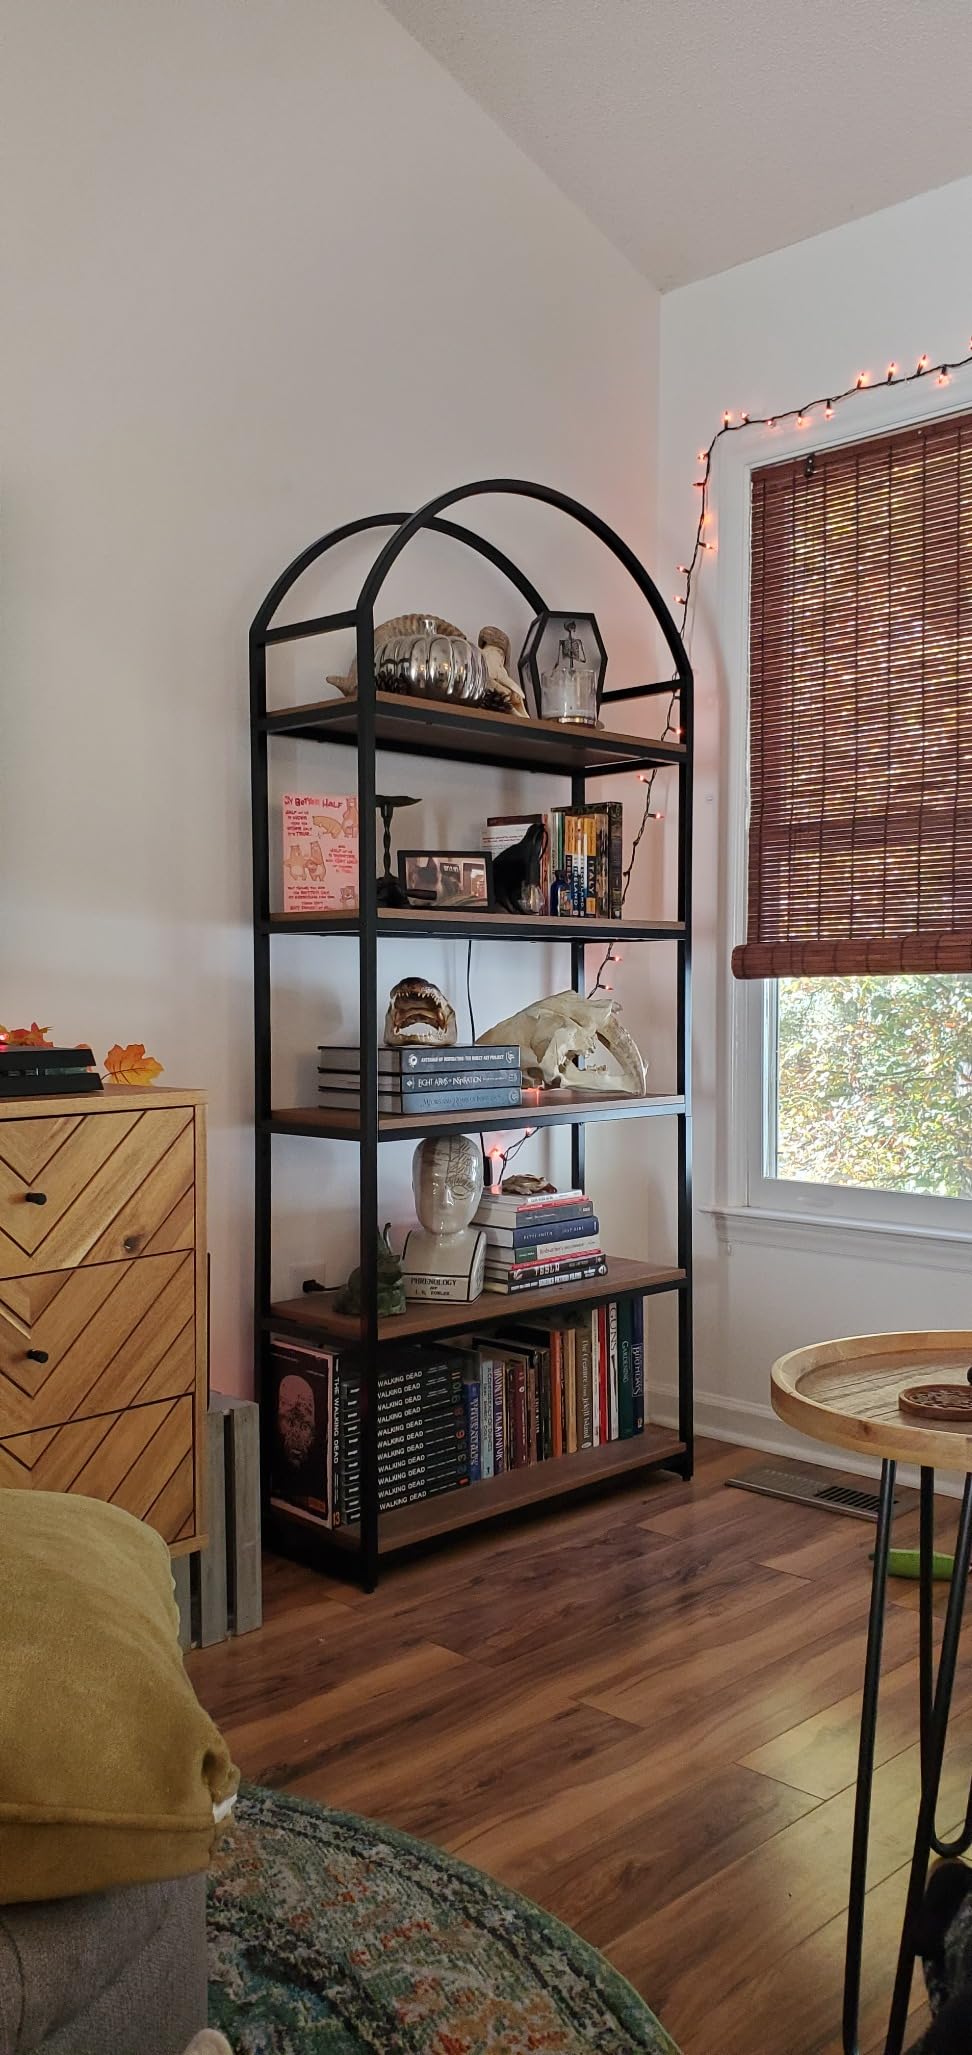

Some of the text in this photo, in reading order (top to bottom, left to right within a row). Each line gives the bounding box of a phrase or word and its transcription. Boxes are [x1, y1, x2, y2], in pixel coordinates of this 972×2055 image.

[410, 1277, 457, 1286] PHRENOLOGY
[609, 1307, 617, 1351] GUNS
[378, 1370, 423, 1388] WALKING DEAD
[403, 1382, 421, 1392] DEAD
[404, 1394, 422, 1405] DEAD
[403, 1406, 421, 1417] DEAD
[377, 1424, 405, 1438] WALKING
[405, 1419, 423, 1430] DEAD
[377, 1435, 405, 1449] WALKING
[406, 1430, 424, 1441] DEAD
[377, 1447, 405, 1461] WALKING
[406, 1442, 424, 1453] DEAD
[377, 1460, 407, 1474] WALKING
[407, 1454, 426, 1465] DEAD
[378, 1472, 407, 1486] WALKING
[407, 1466, 426, 1477] DEAD
[378, 1484, 407, 1499] WALKING
[408, 1478, 426, 1490] DEAD
[379, 1496, 408, 1511] WALKING
[409, 1490, 427, 1502] DEAD
[333, 1511, 341, 1526] 13
